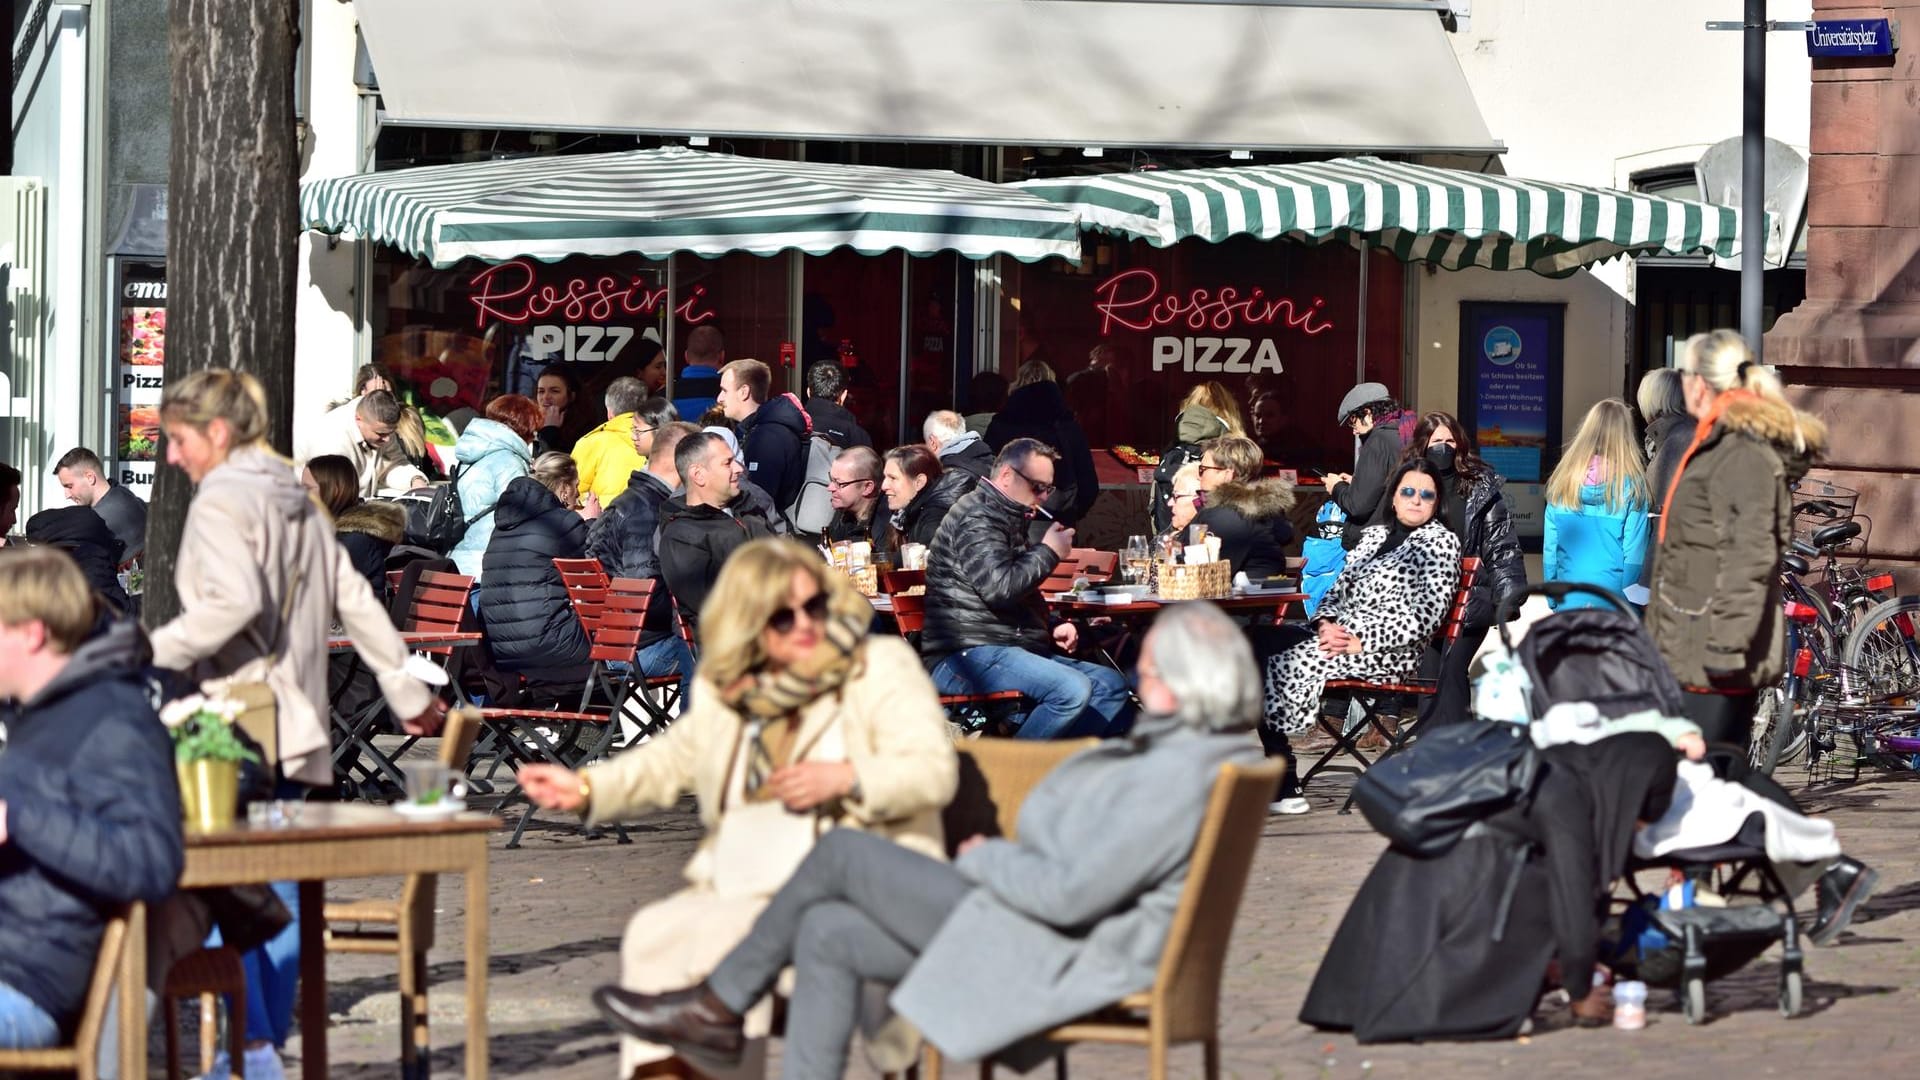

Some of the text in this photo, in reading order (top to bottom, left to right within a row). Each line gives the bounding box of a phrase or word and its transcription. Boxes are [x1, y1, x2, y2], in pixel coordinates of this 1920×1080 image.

[1813, 24, 1877, 51] Universitätsplatz
[470, 261, 715, 328] Rossini
[1096, 269, 1332, 335] Rossini
[532, 325, 664, 362] PIZZ
[1152, 336, 1284, 375] PIZZA
[1491, 372, 1514, 380] Schloss
[1527, 361, 1537, 369] Sie
